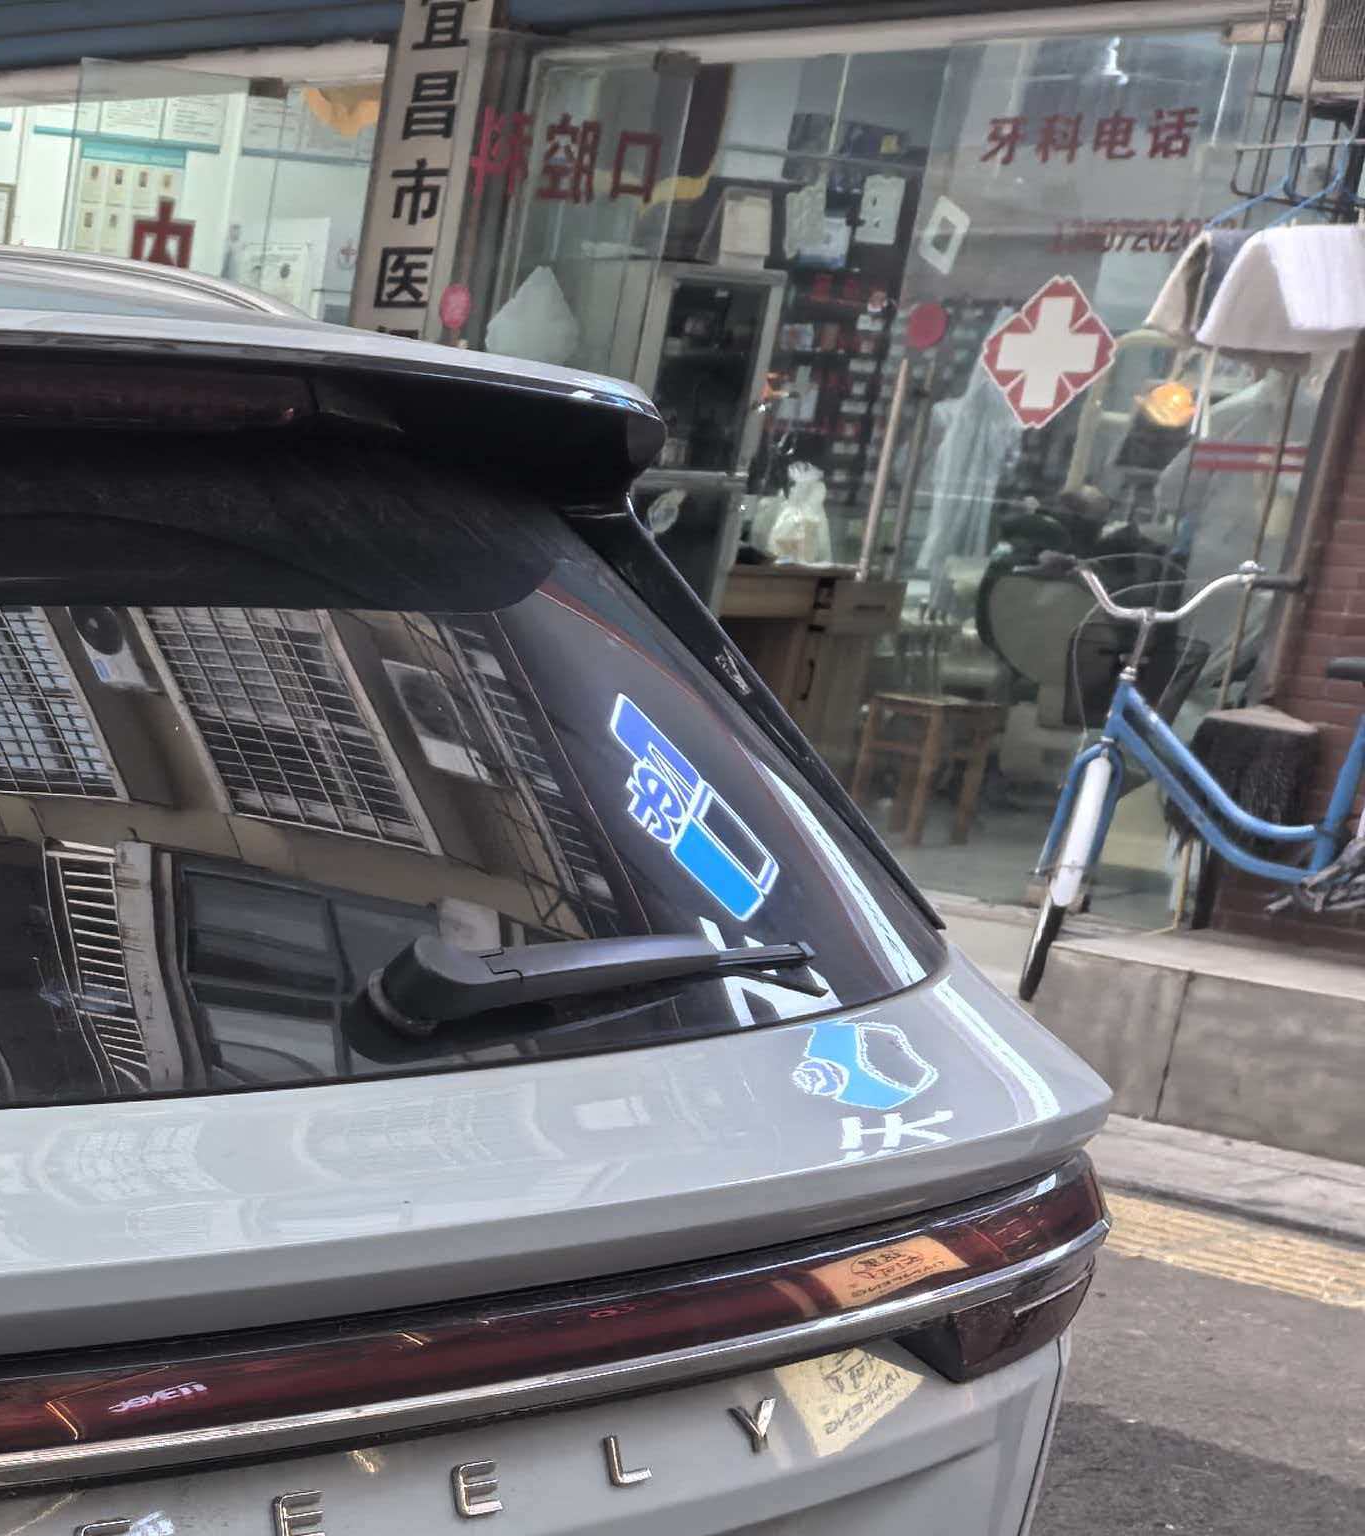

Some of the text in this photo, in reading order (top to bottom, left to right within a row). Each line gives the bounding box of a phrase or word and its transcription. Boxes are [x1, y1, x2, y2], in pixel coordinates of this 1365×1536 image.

[373, 0, 468, 340] 宜昌市医
[979, 106, 1200, 166] 牙科电话
